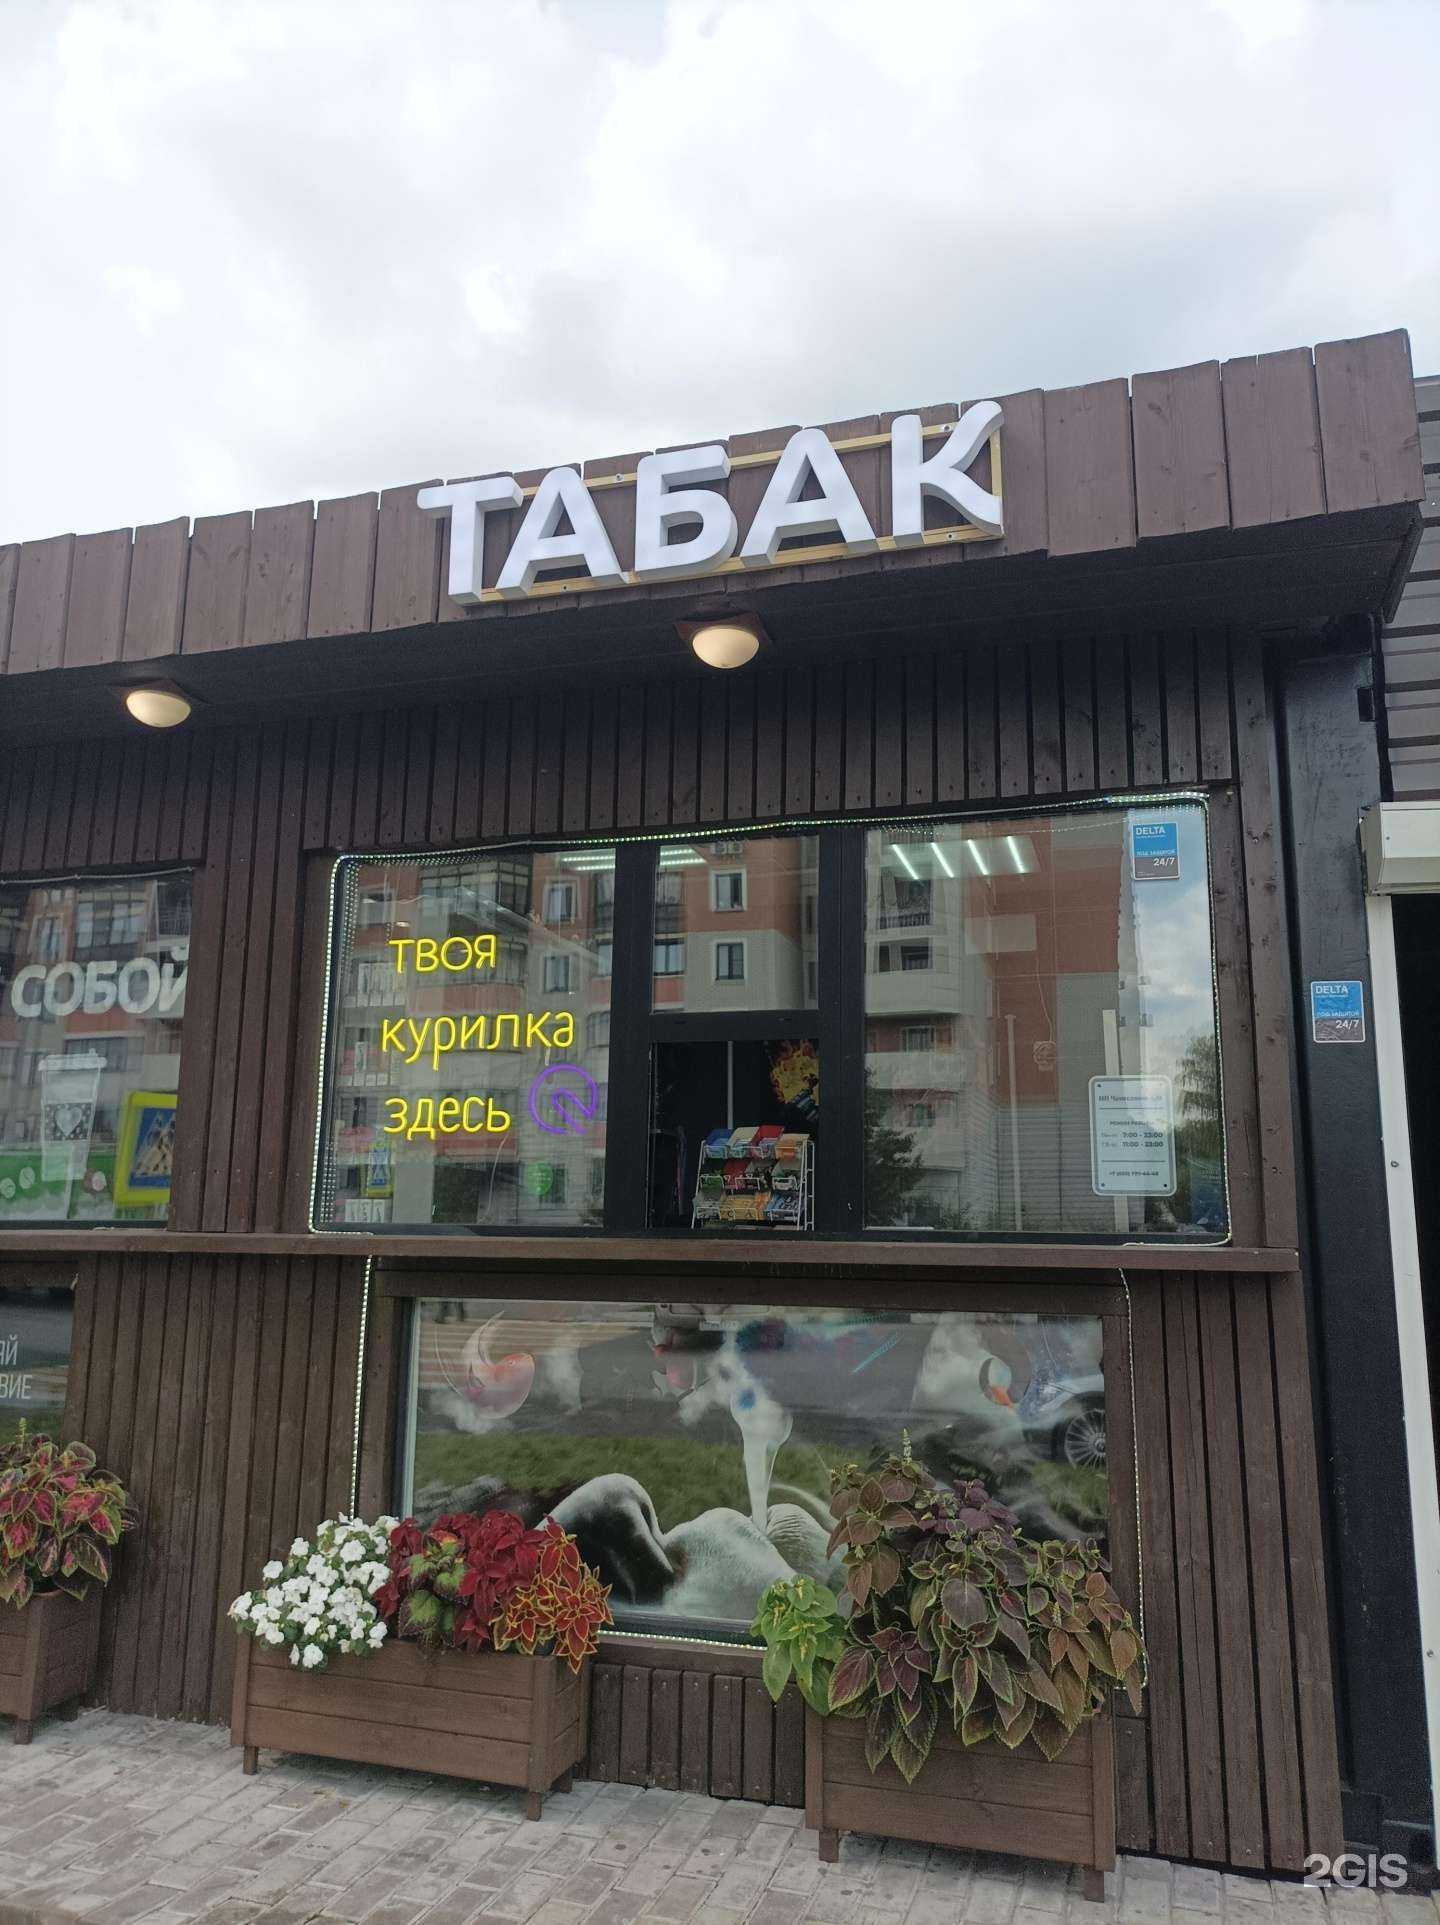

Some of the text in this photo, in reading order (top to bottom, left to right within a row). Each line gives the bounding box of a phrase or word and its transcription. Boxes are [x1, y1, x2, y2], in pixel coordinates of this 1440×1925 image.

[417, 400, 1005, 602] ТАБАК
[1135, 826, 1166, 835] DELTA
[1153, 857, 1176, 867] 24/7
[1315, 985, 1349, 994] DELTA
[1335, 1019, 1360, 1030] 24/7
[382, 1011, 575, 1072] курилка
[383, 1096, 512, 1141] здесь
